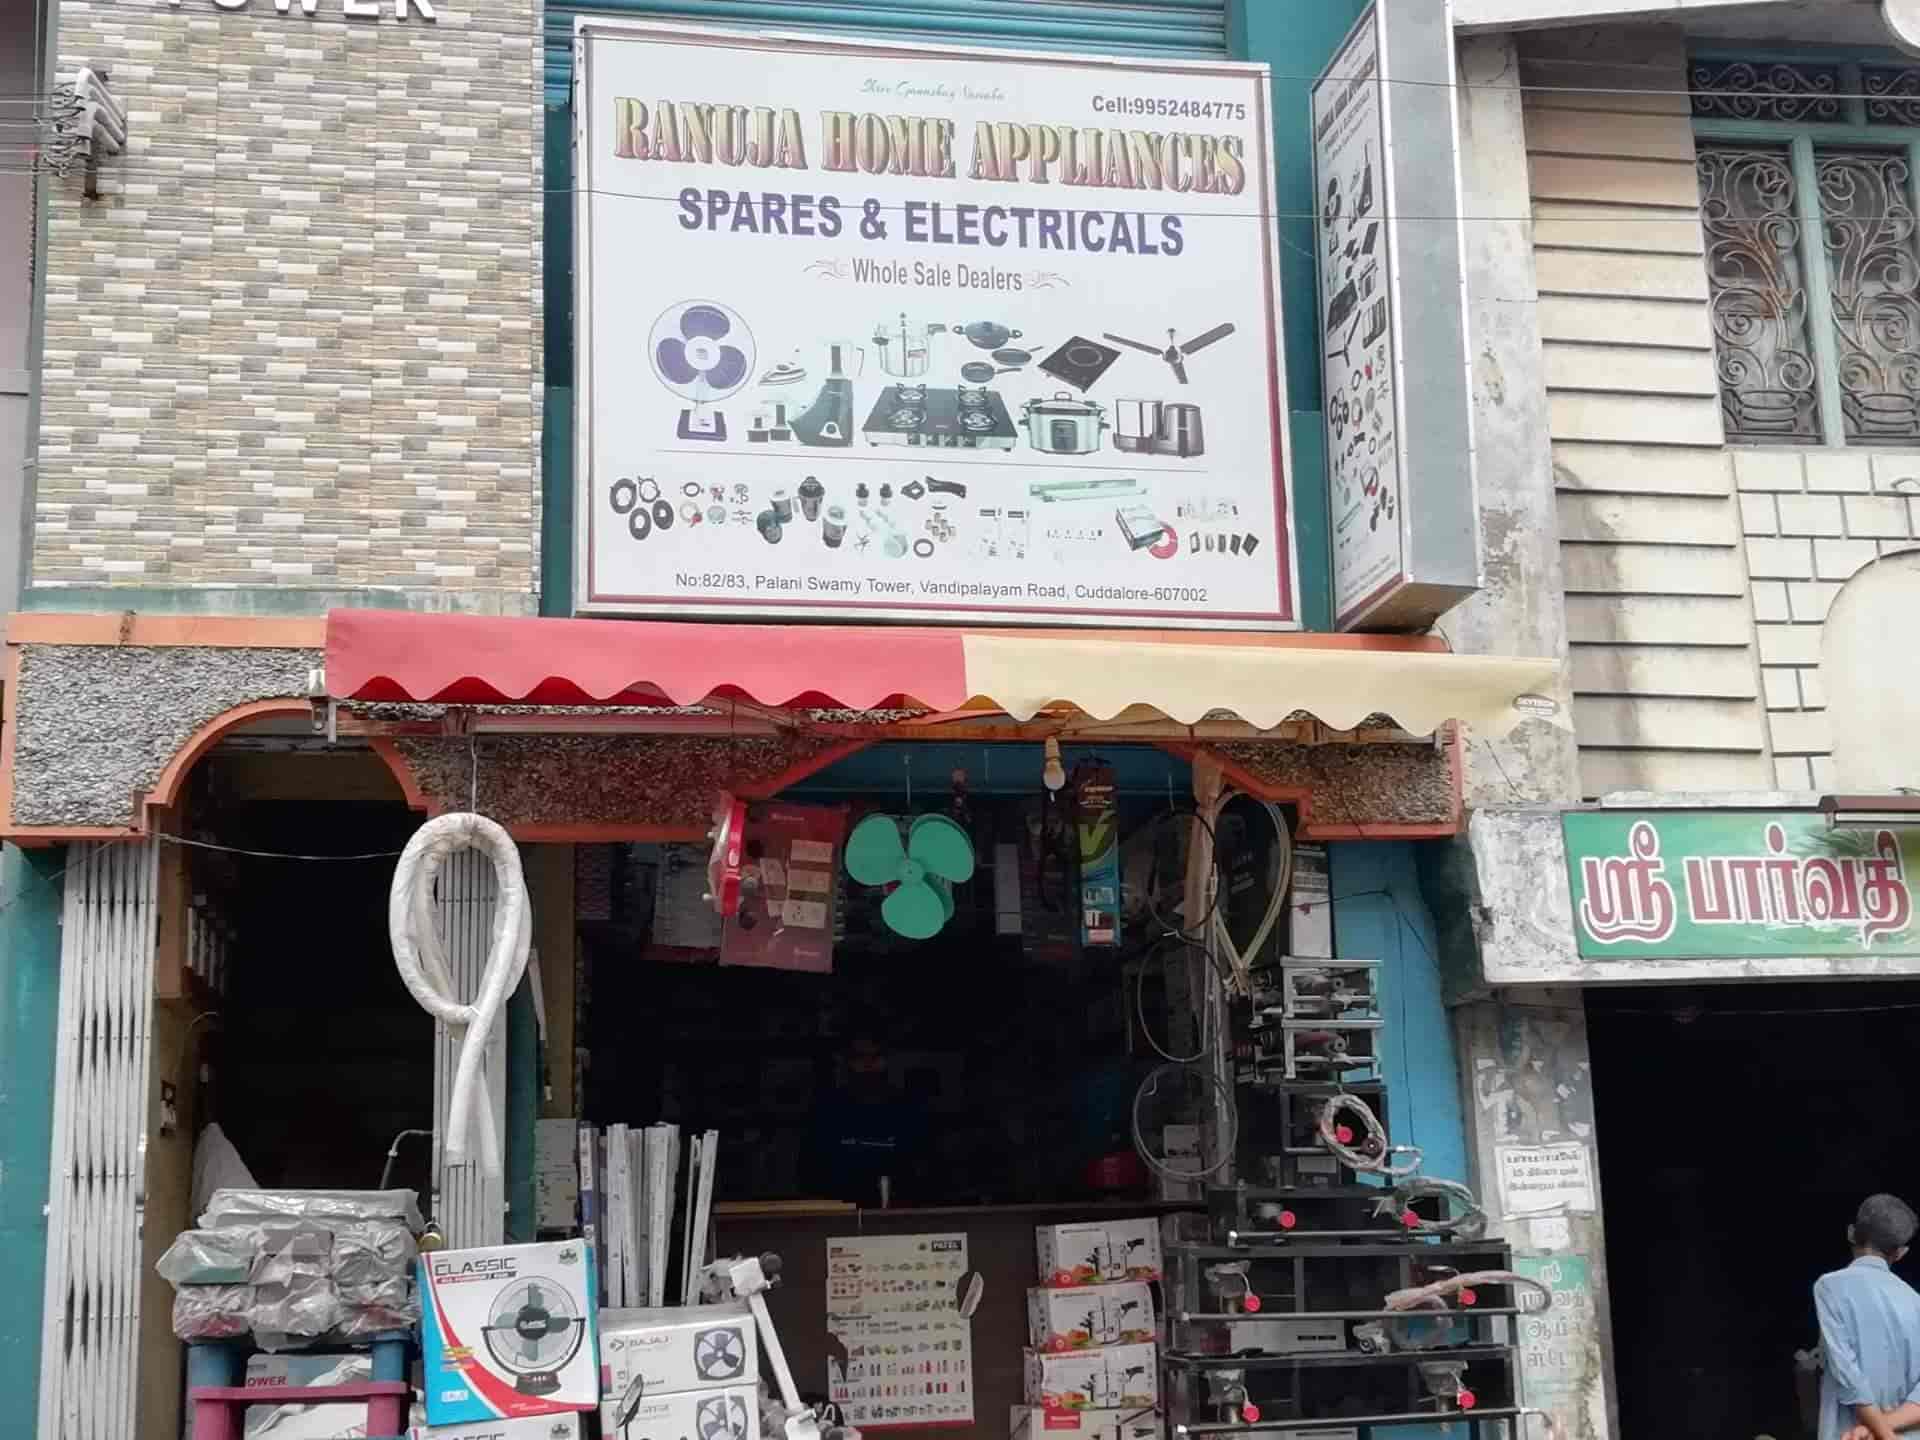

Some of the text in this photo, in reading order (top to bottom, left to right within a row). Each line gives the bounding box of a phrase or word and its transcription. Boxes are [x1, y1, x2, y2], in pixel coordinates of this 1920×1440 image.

[1092, 95, 1246, 120] Cell:9952484775
[614, 97, 808, 170] RANUJA
[820, 110, 956, 178] HOME
[968, 120, 1246, 195] APPLIANCES
[678, 187, 1185, 256] SPARES & ELECTRICALS
[852, 257, 1022, 291] Whole Sale Dealers
[676, 573, 1208, 601] No:82/83, Palani Swamy Tower, Vandipalayam Road, Cuddalore-607002
[435, 1257, 516, 1276] CLASSIC
